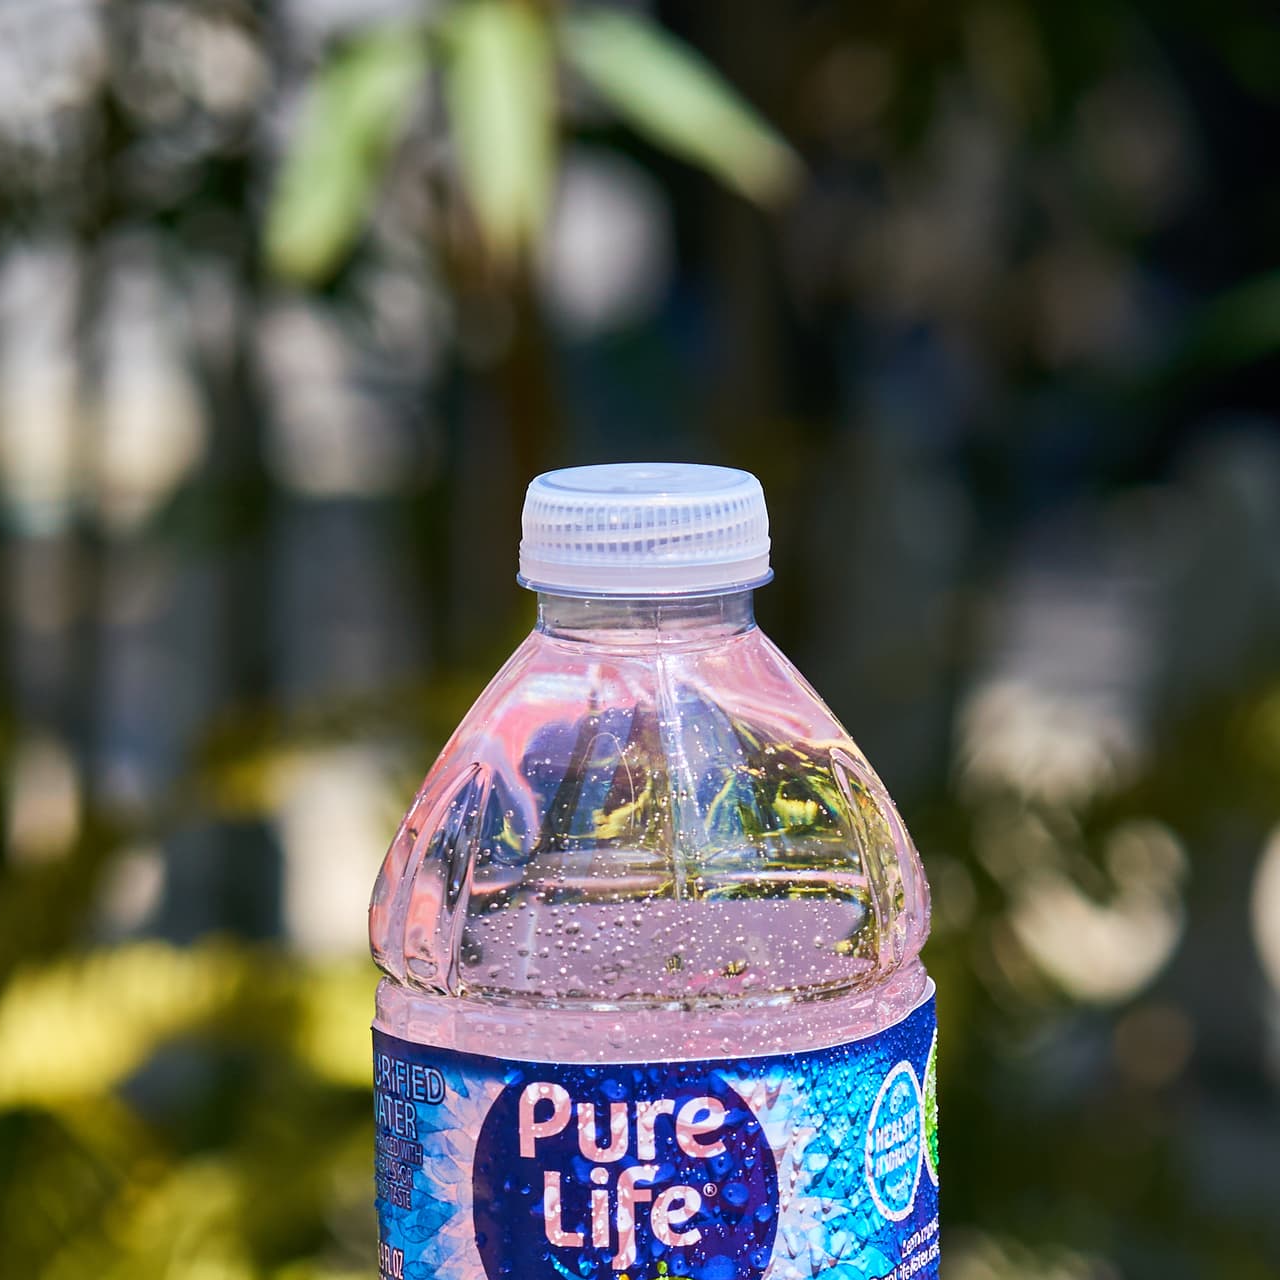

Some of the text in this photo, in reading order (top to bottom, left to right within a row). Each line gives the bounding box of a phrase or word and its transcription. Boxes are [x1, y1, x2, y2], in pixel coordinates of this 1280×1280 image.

[374, 1053, 445, 1103] URIFIED
[519, 1082, 726, 1163] Pure
[392, 1249, 404, 1280] OZ
